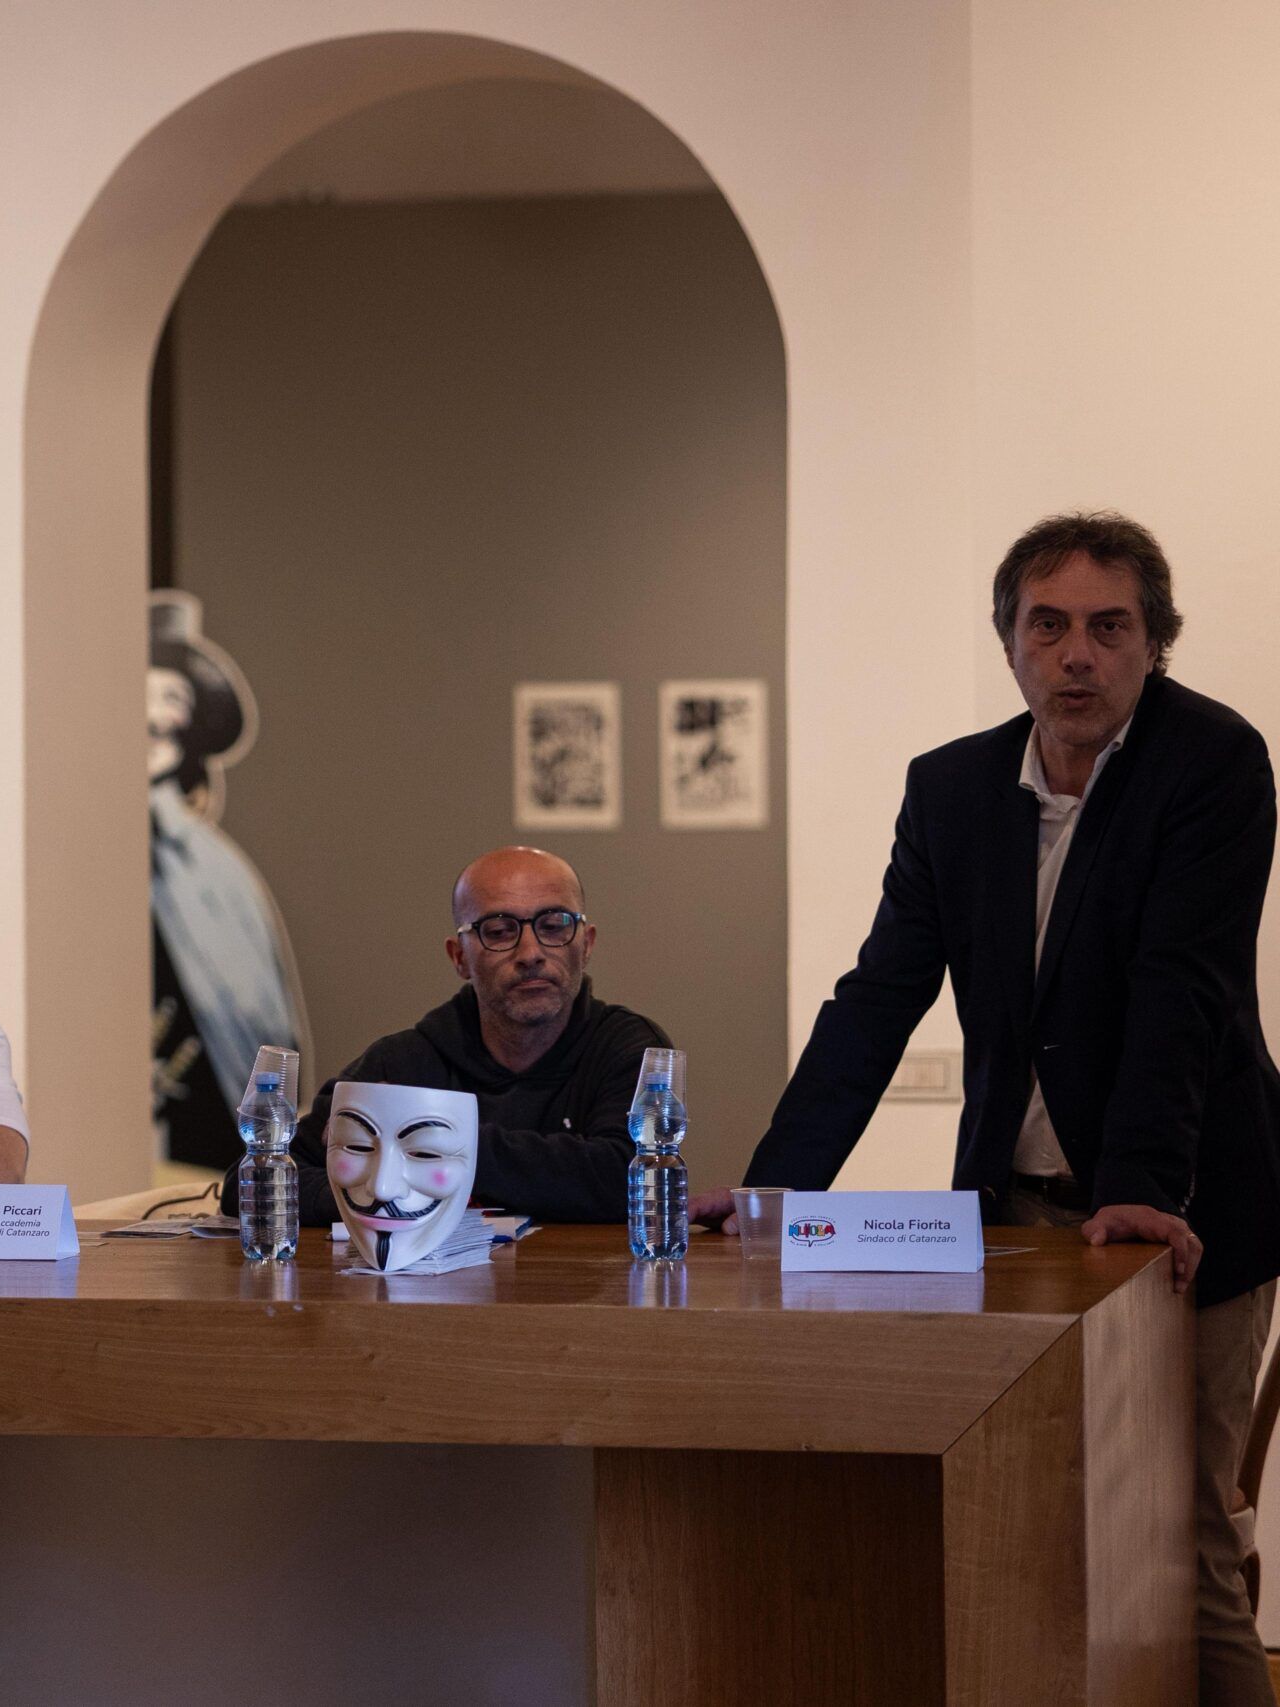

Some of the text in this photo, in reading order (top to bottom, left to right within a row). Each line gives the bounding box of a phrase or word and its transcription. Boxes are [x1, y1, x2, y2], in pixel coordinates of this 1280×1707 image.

[3, 1206, 42, 1216] Piccari
[864, 1219, 951, 1230] Nicola Fiorita
[6, 1229, 50, 1237] Catanzaro
[857, 1234, 957, 1243] Sindaco di Catanzaro
